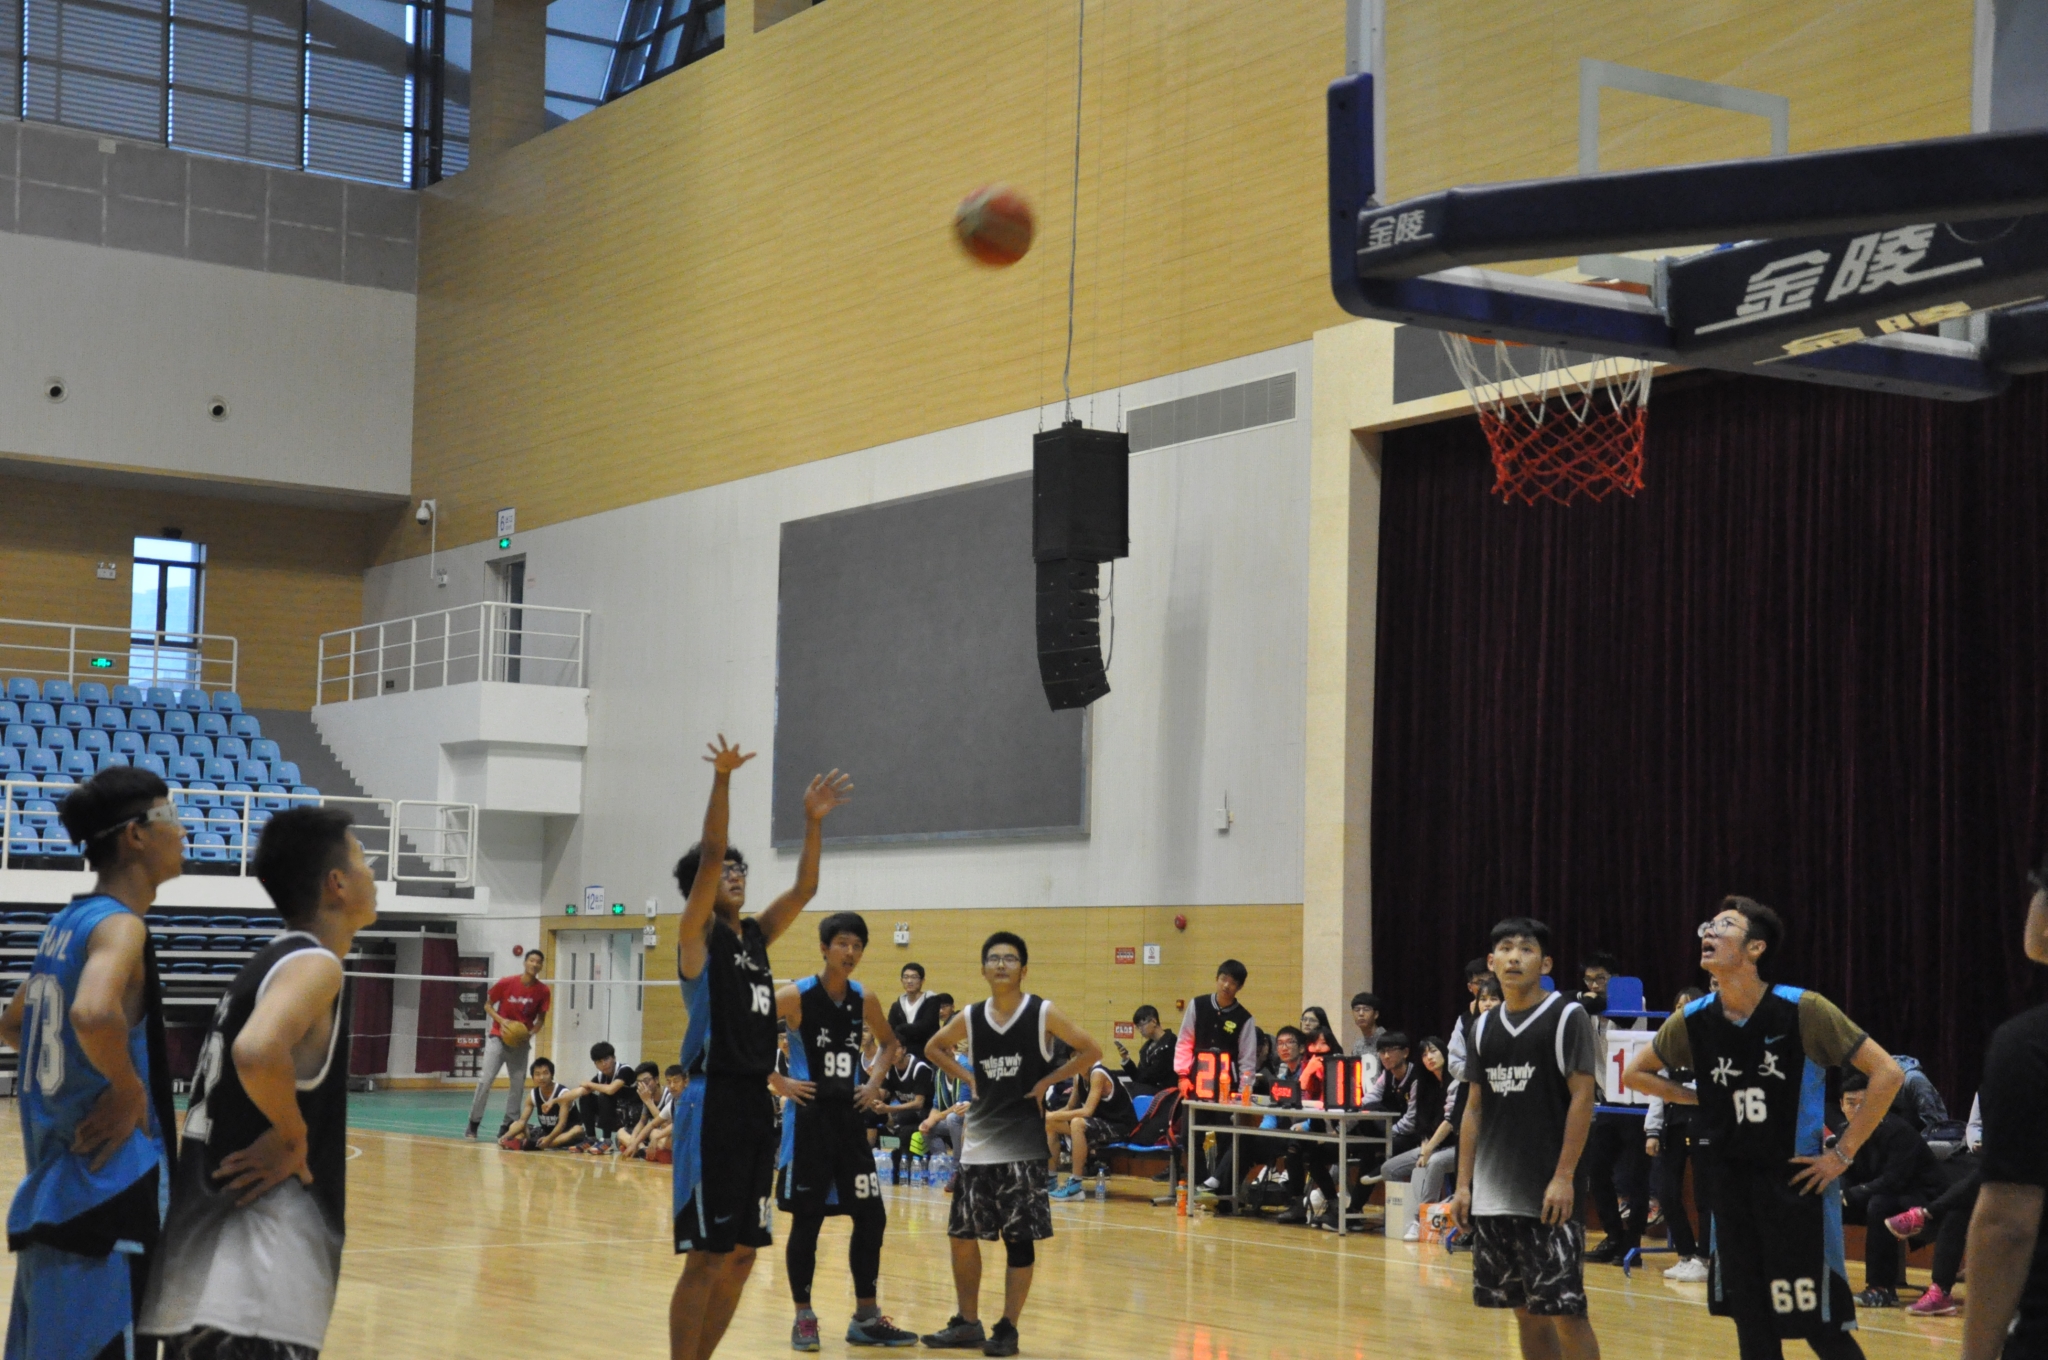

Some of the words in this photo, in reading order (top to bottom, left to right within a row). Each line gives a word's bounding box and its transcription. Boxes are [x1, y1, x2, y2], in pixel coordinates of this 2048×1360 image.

[1357, 209, 1434, 255] 金陵
[1695, 223, 1984, 335] 金陵
[824, 1052, 851, 1077] 99
[1710, 1050, 1786, 1087] 水文
[854, 1172, 879, 1198] 99
[1770, 1278, 1817, 1313] 66
